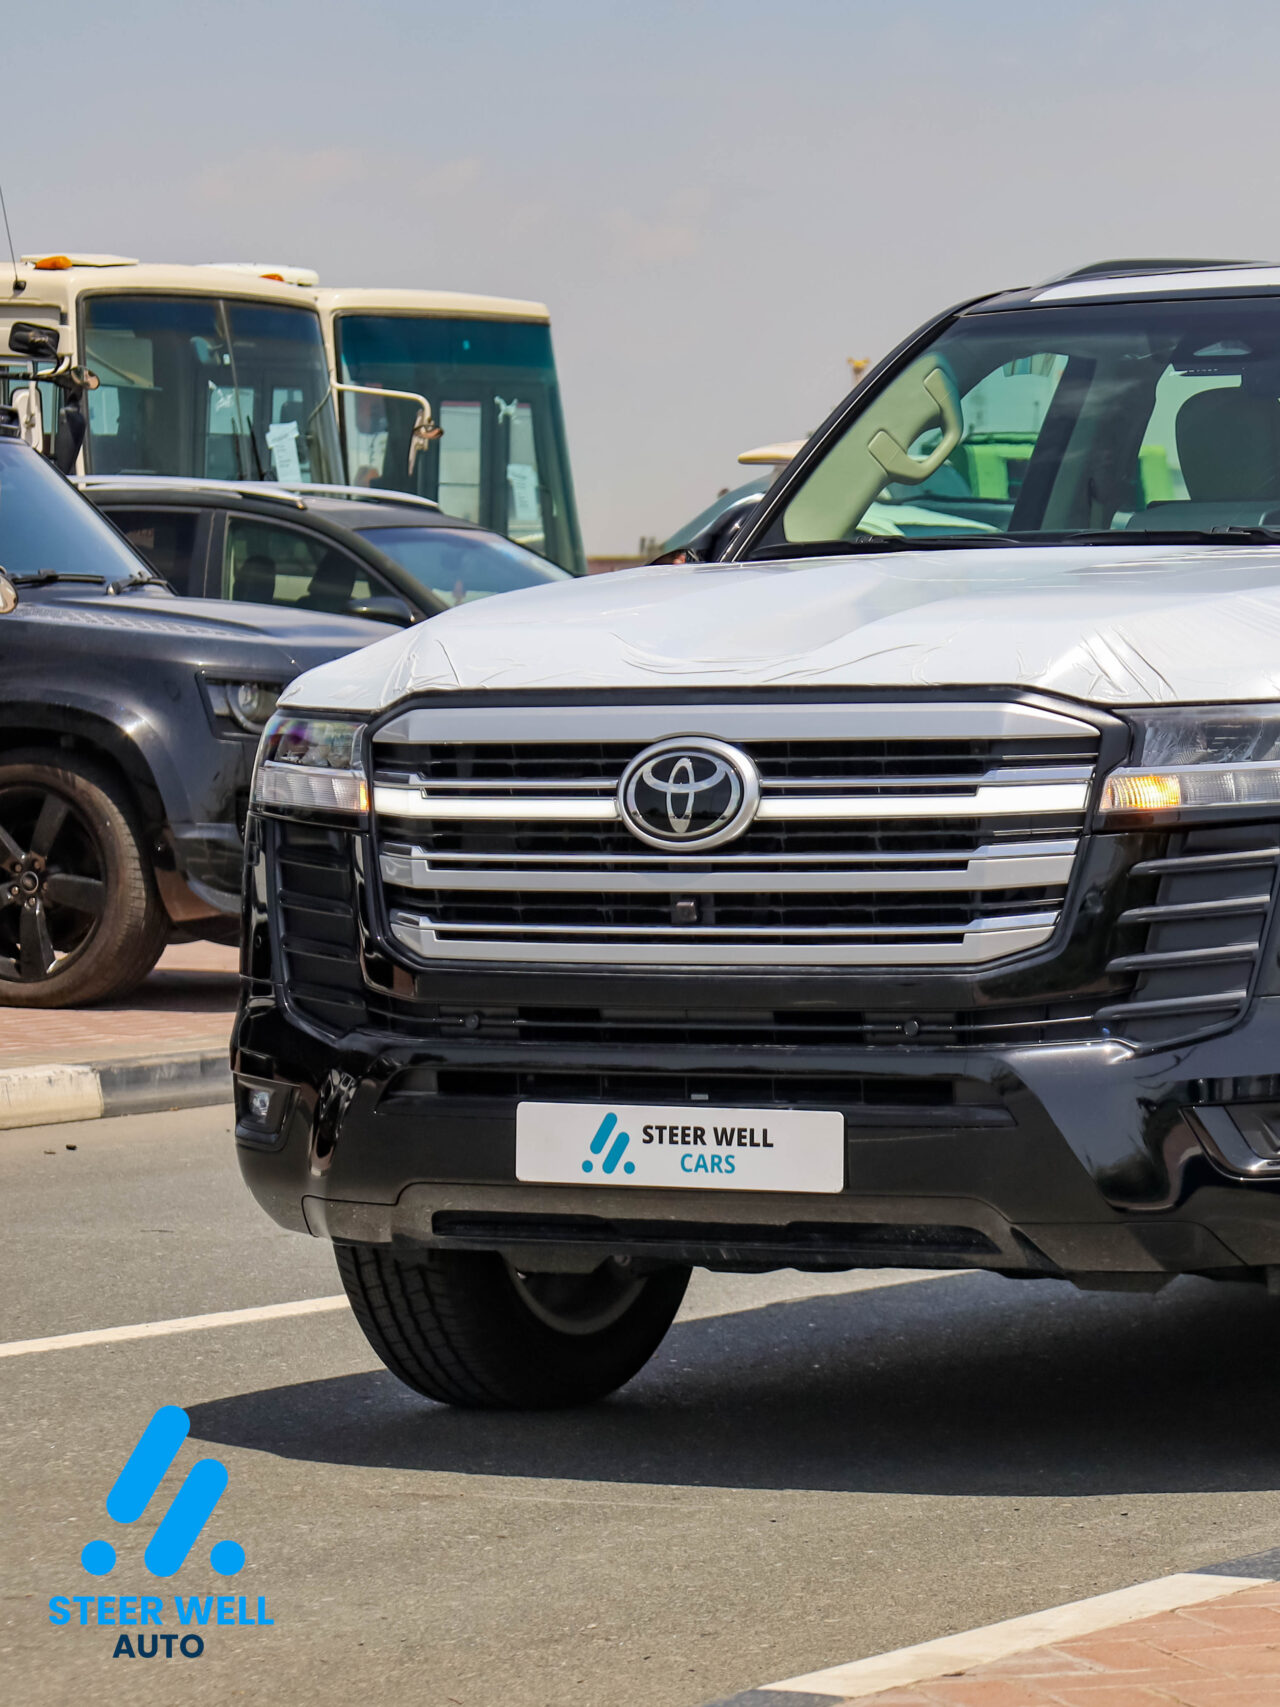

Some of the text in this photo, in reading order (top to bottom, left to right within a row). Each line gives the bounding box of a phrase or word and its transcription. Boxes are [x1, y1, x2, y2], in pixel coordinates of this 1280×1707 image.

[643, 1125, 773, 1147] STEER WELL
[681, 1153, 735, 1174] CARS
